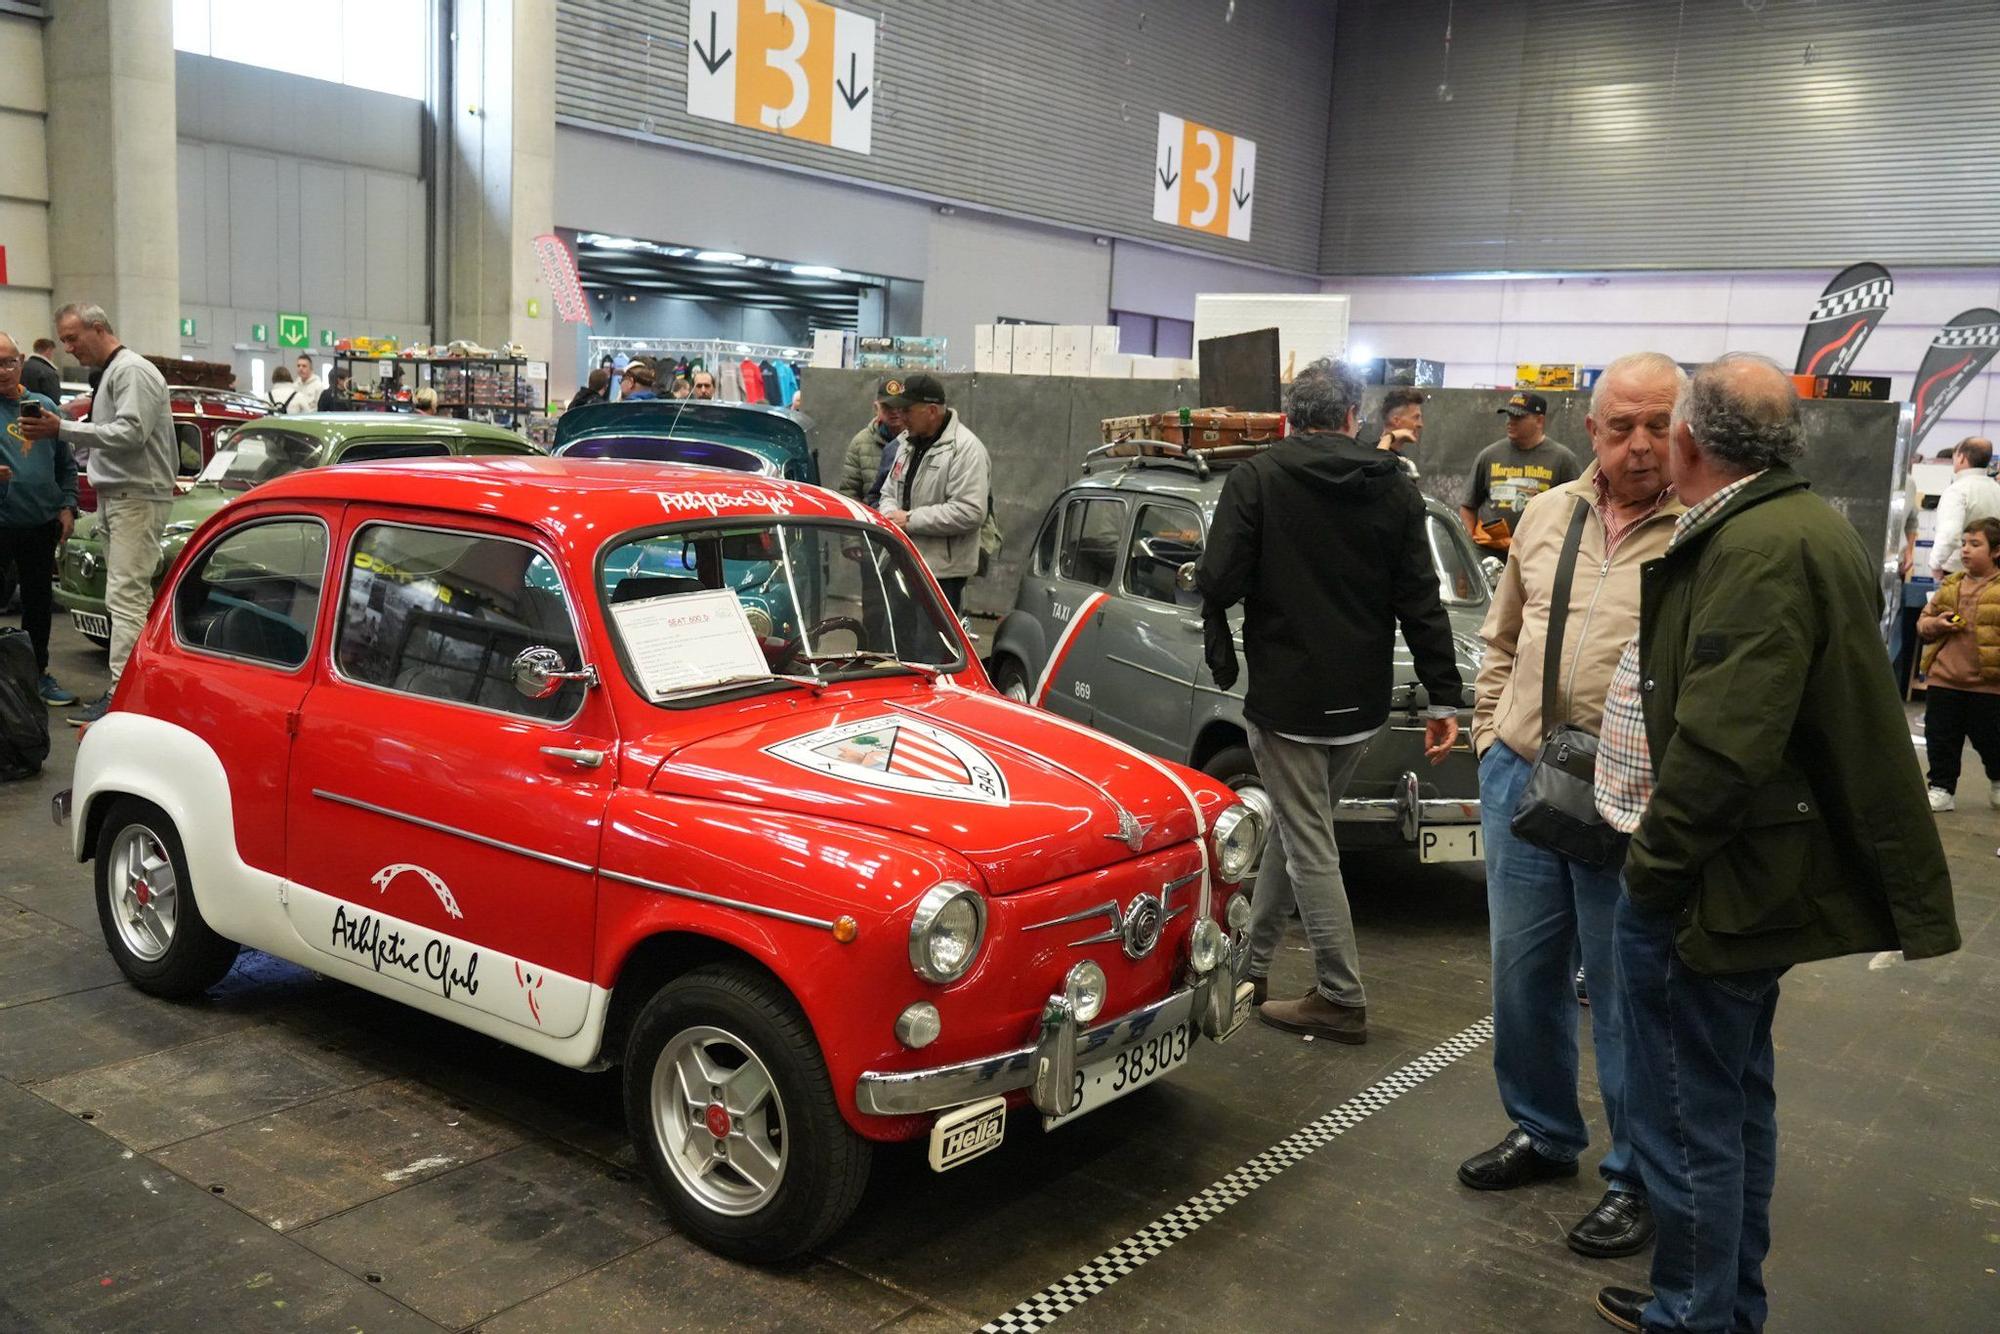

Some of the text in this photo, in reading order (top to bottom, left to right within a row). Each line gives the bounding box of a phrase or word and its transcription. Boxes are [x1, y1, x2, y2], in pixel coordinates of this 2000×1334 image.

[758, 0, 810, 130] 3
[1190, 129, 1220, 227] 3
[1491, 463, 1553, 480] Morgan Wallen
[667, 616, 686, 626] SEAT
[688, 614, 702, 624] 600
[1052, 602, 1071, 622] TAXI
[1074, 680, 1091, 700] 869
[1423, 832, 1438, 859] P
[332, 905, 479, 999] Athletic Club
[1112, 1024, 1187, 1091] 38303
[946, 1119, 1000, 1156] Hella
